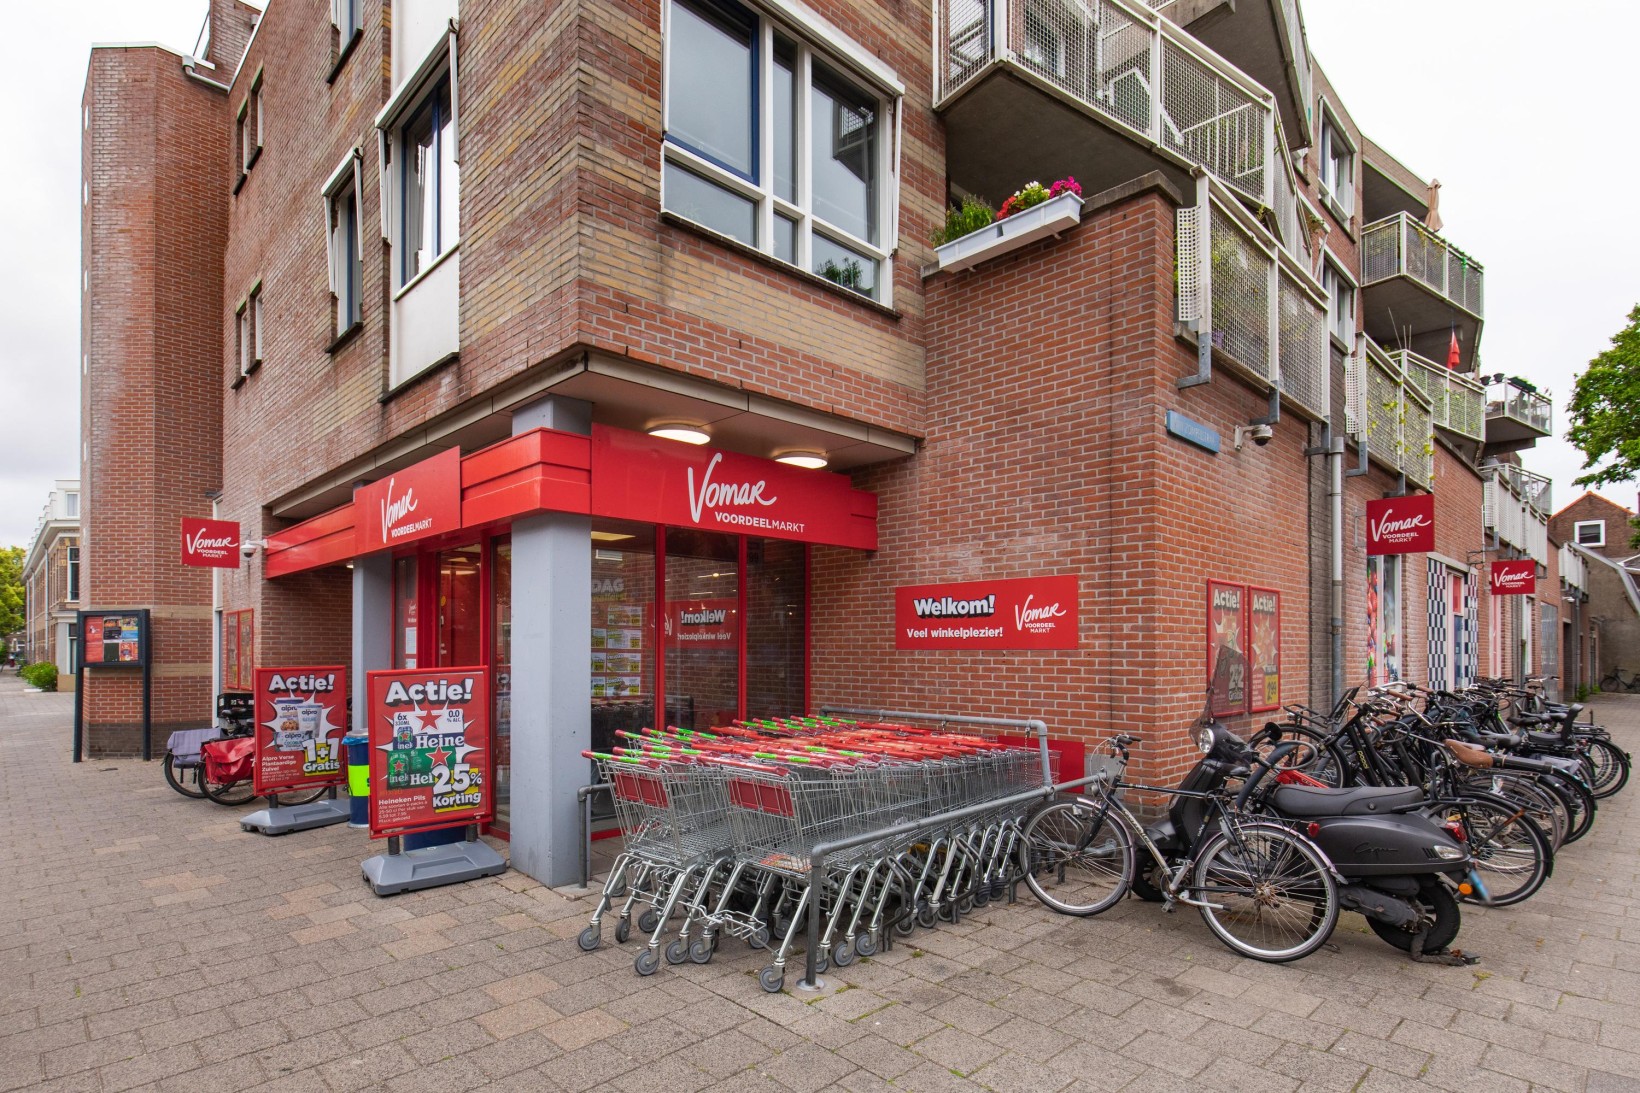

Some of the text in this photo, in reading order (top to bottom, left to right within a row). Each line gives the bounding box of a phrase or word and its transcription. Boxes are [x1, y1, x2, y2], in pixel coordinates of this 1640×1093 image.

[687, 452, 777, 524] Vomar
[381, 477, 418, 544] Vomar
[391, 517, 433, 538] VOORDEELMARKT
[714, 511, 805, 533] VOORDEELMARKT
[1371, 508, 1432, 542] Vomar
[186, 527, 239, 555] Vomar
[1494, 567, 1534, 587] Vomar
[914, 595, 996, 618] Welkom!
[1213, 588, 1240, 609] Actie!
[1253, 594, 1277, 613] Actie!
[1015, 594, 1067, 631] Vomar
[907, 627, 1004, 640] Veel winkelplezier!
[268, 674, 335, 692] Actie!
[385, 678, 474, 704] Actie!
[448, 710, 460, 718] 0.0
[302, 737, 340, 762] 1+1
[416, 734, 465, 748] Heine
[303, 760, 340, 772] Gratis
[379, 797, 412, 805] Heineken
[432, 792, 482, 808] Korting
